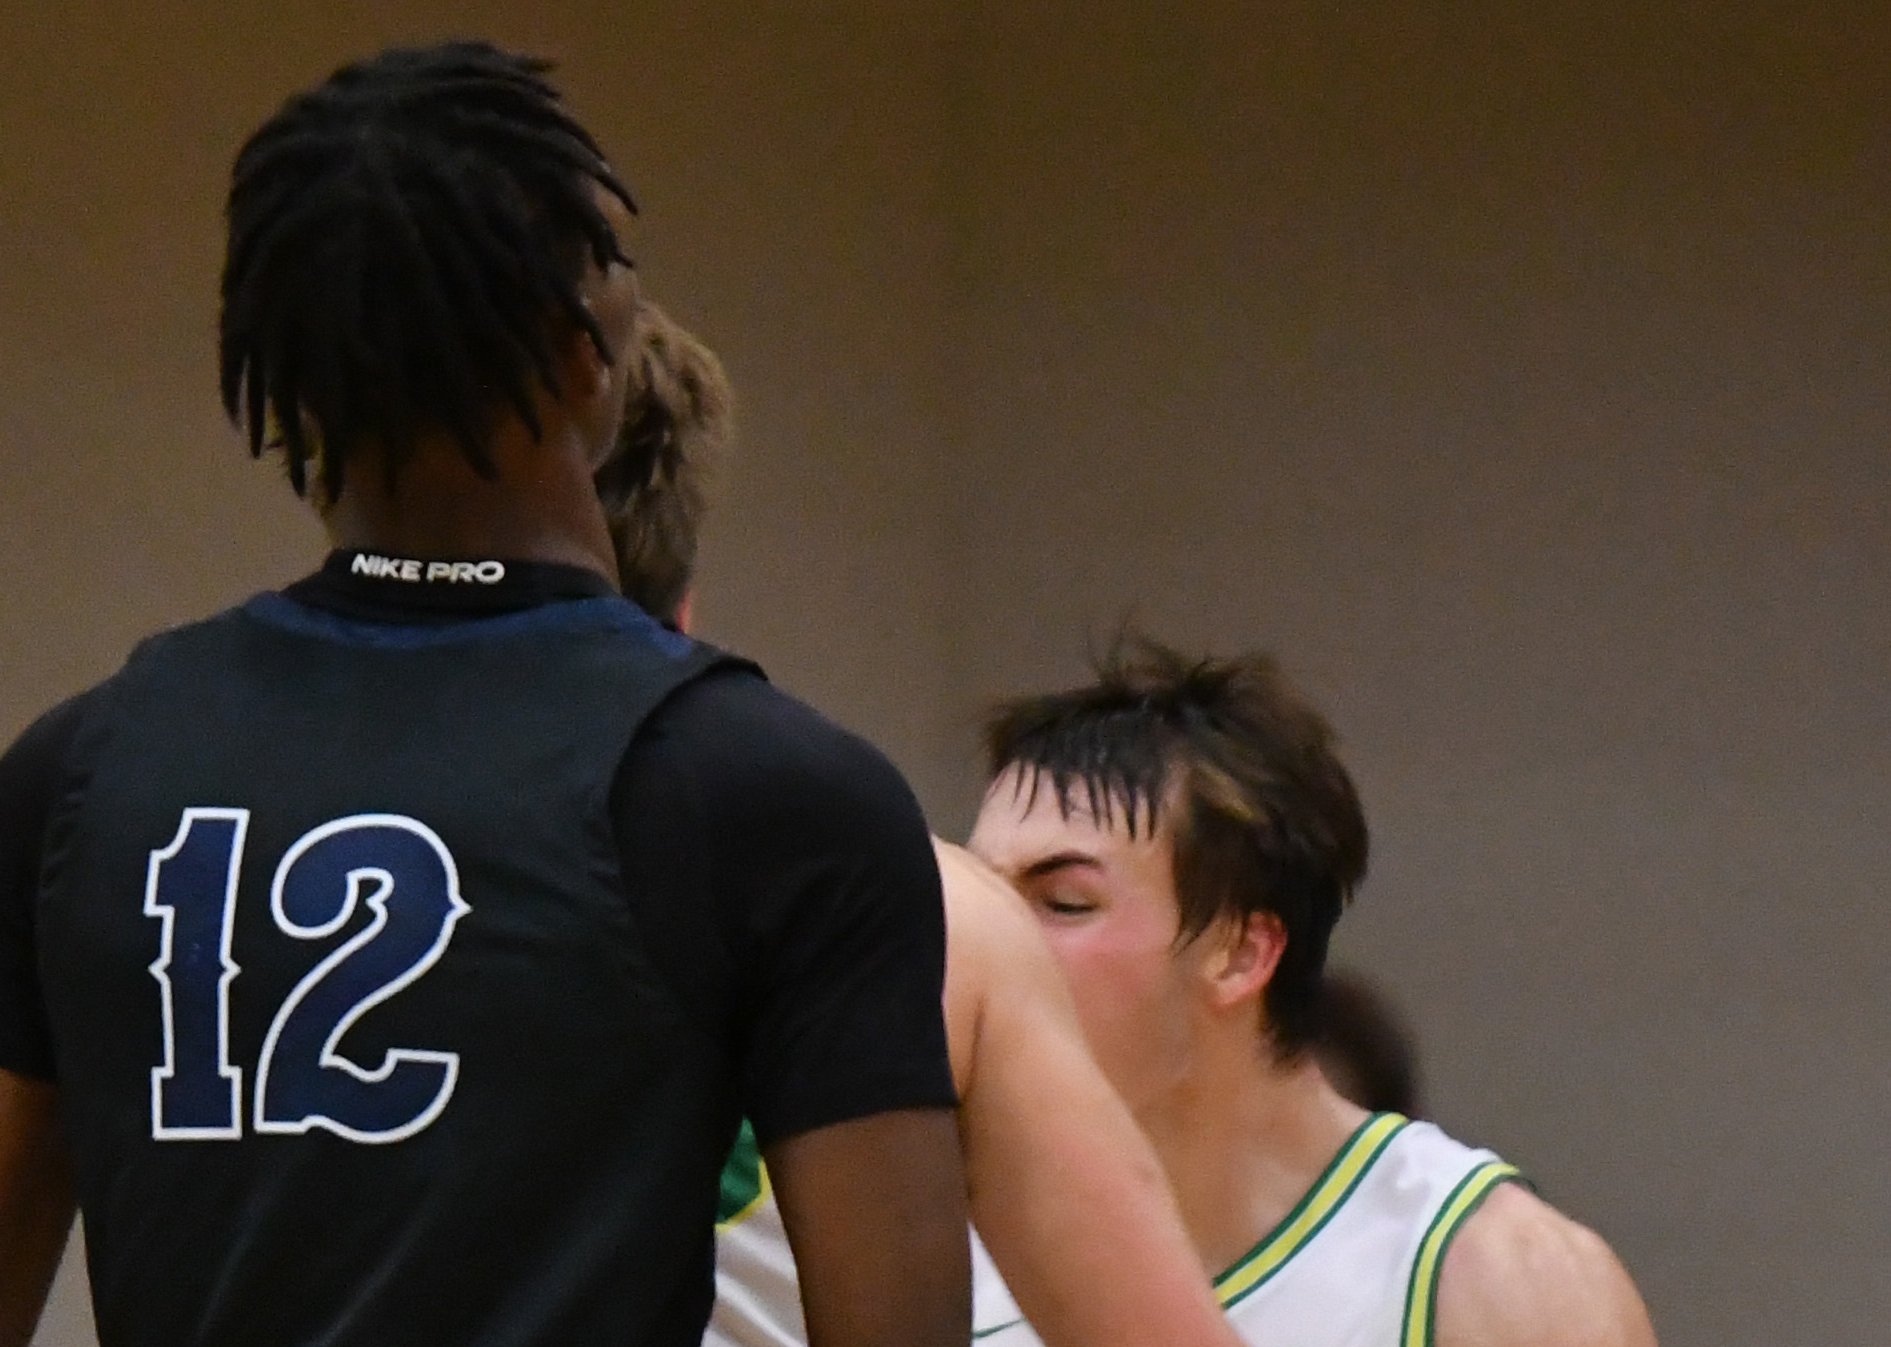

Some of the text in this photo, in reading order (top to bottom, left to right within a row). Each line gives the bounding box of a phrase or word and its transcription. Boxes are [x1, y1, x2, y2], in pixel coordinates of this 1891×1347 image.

[350, 552, 506, 584] NIKE PRO
[143, 807, 472, 1145] 12
